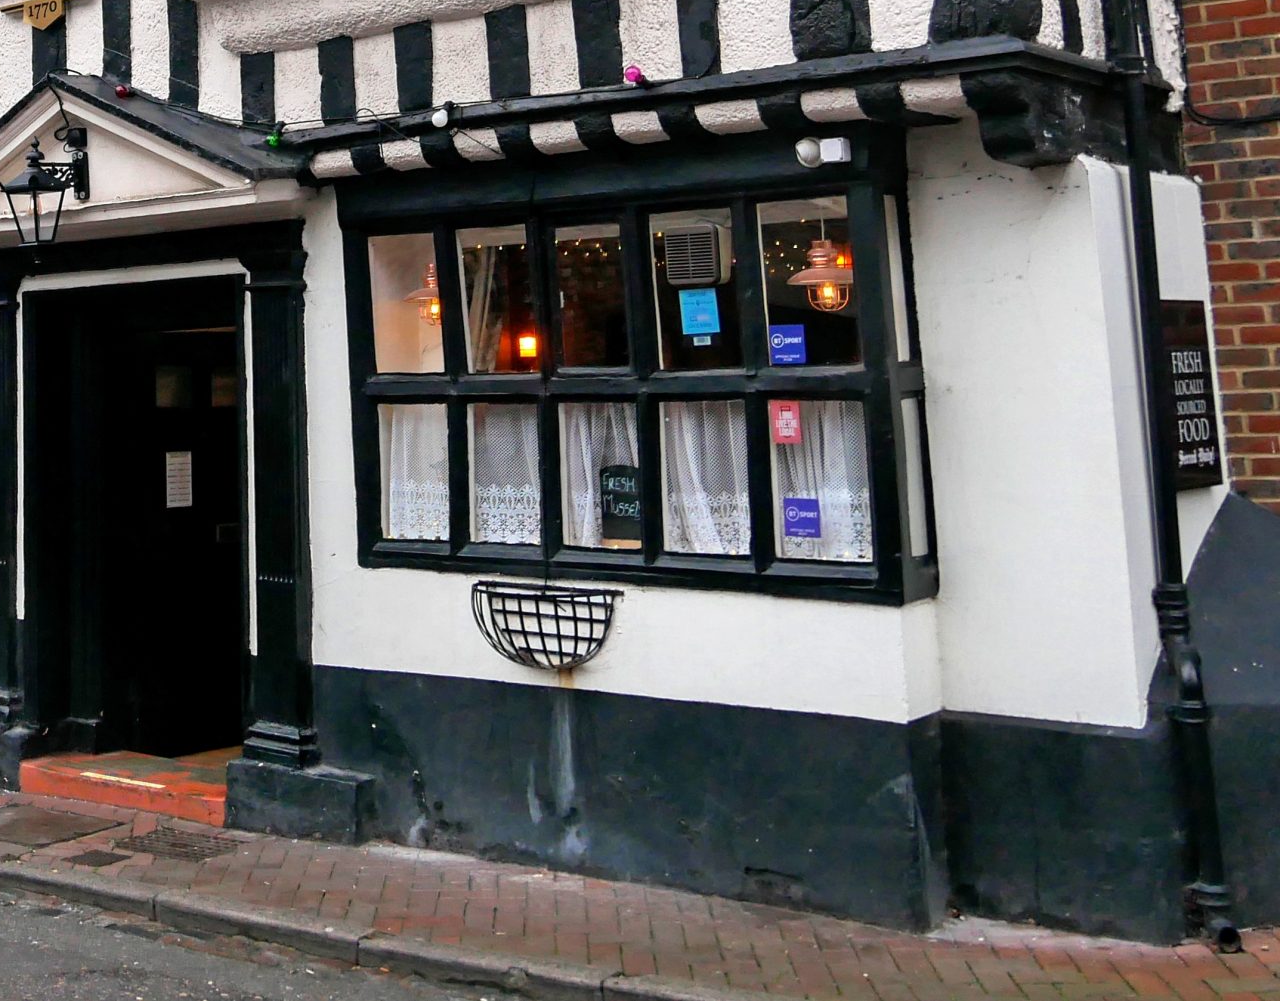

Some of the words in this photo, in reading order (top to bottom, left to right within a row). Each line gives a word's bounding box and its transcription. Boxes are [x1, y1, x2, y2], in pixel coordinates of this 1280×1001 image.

[27, 0, 57, 20] 1770
[785, 336, 802, 344] SPORT
[1171, 351, 1202, 374] FRESH
[1174, 379, 1205, 395] LOCALLY
[1177, 400, 1206, 415] SOURCED
[1178, 418, 1209, 443] FOOD
[603, 473, 635, 492] FRESH
